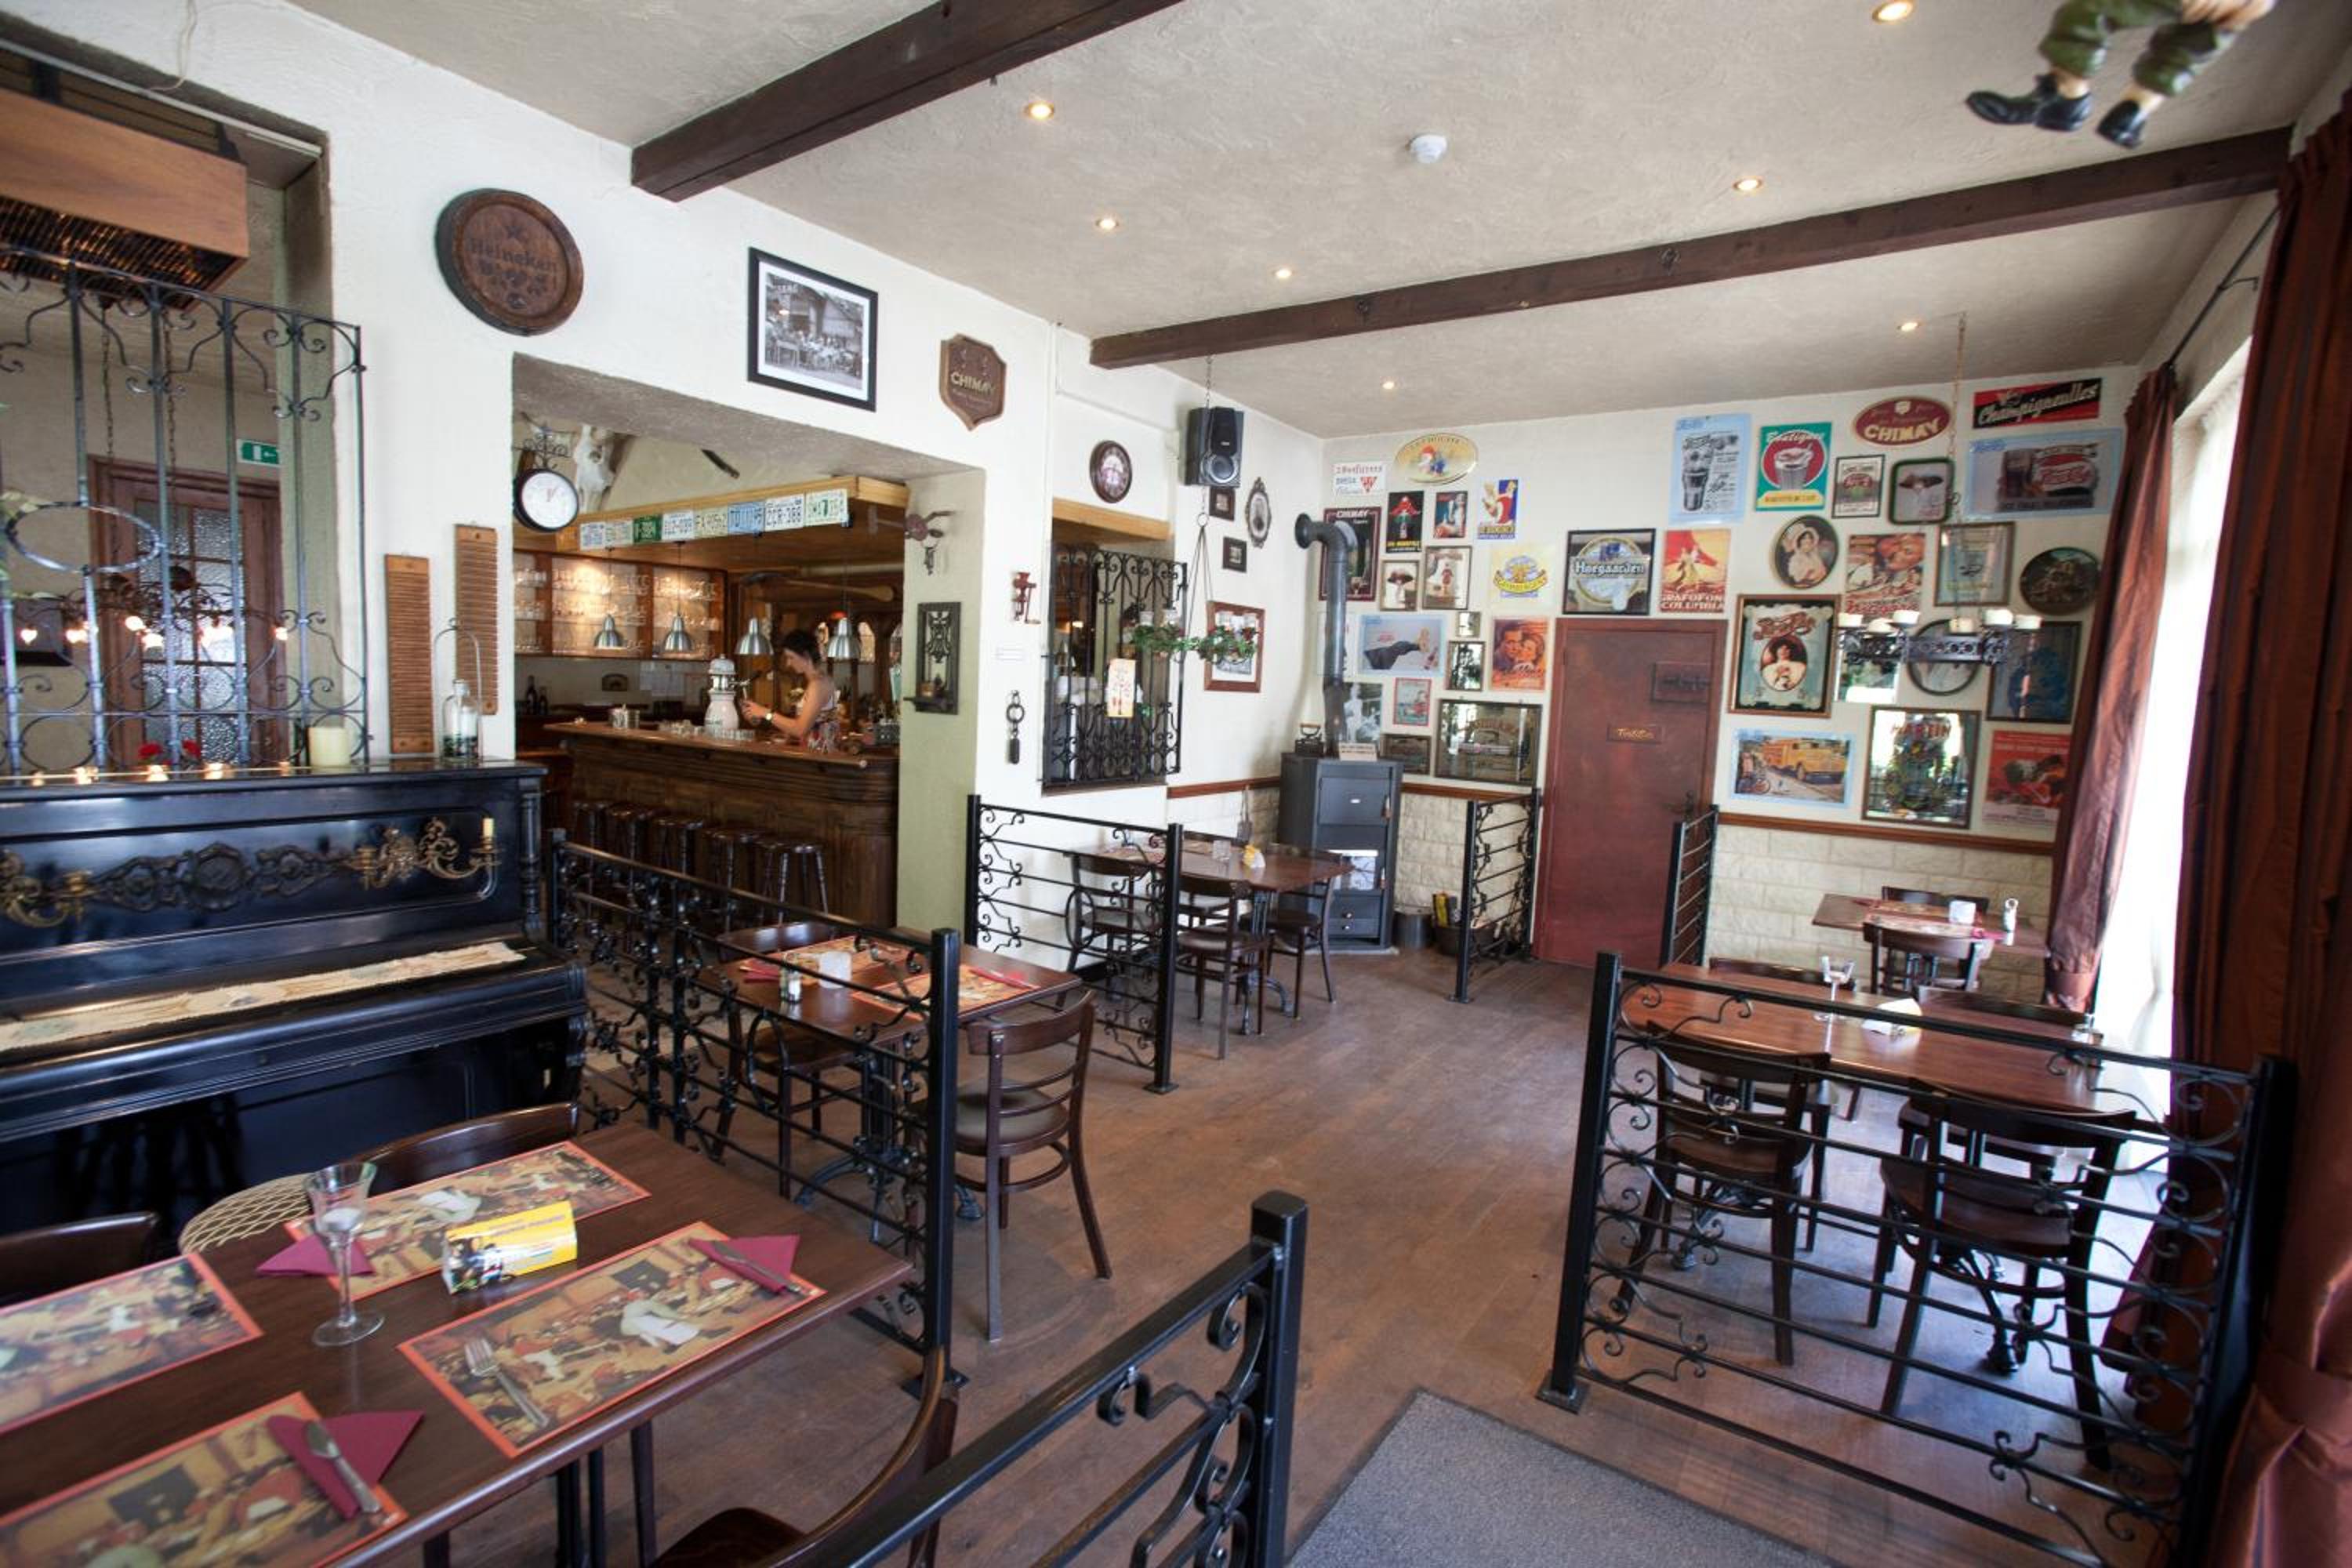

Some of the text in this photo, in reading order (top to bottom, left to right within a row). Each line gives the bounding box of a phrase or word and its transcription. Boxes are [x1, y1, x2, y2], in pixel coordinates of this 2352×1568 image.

[950, 372, 996, 393] CHIMAY
[1864, 416, 1940, 442] CHIMAY
[1574, 559, 1644, 576] Hoegaarden
